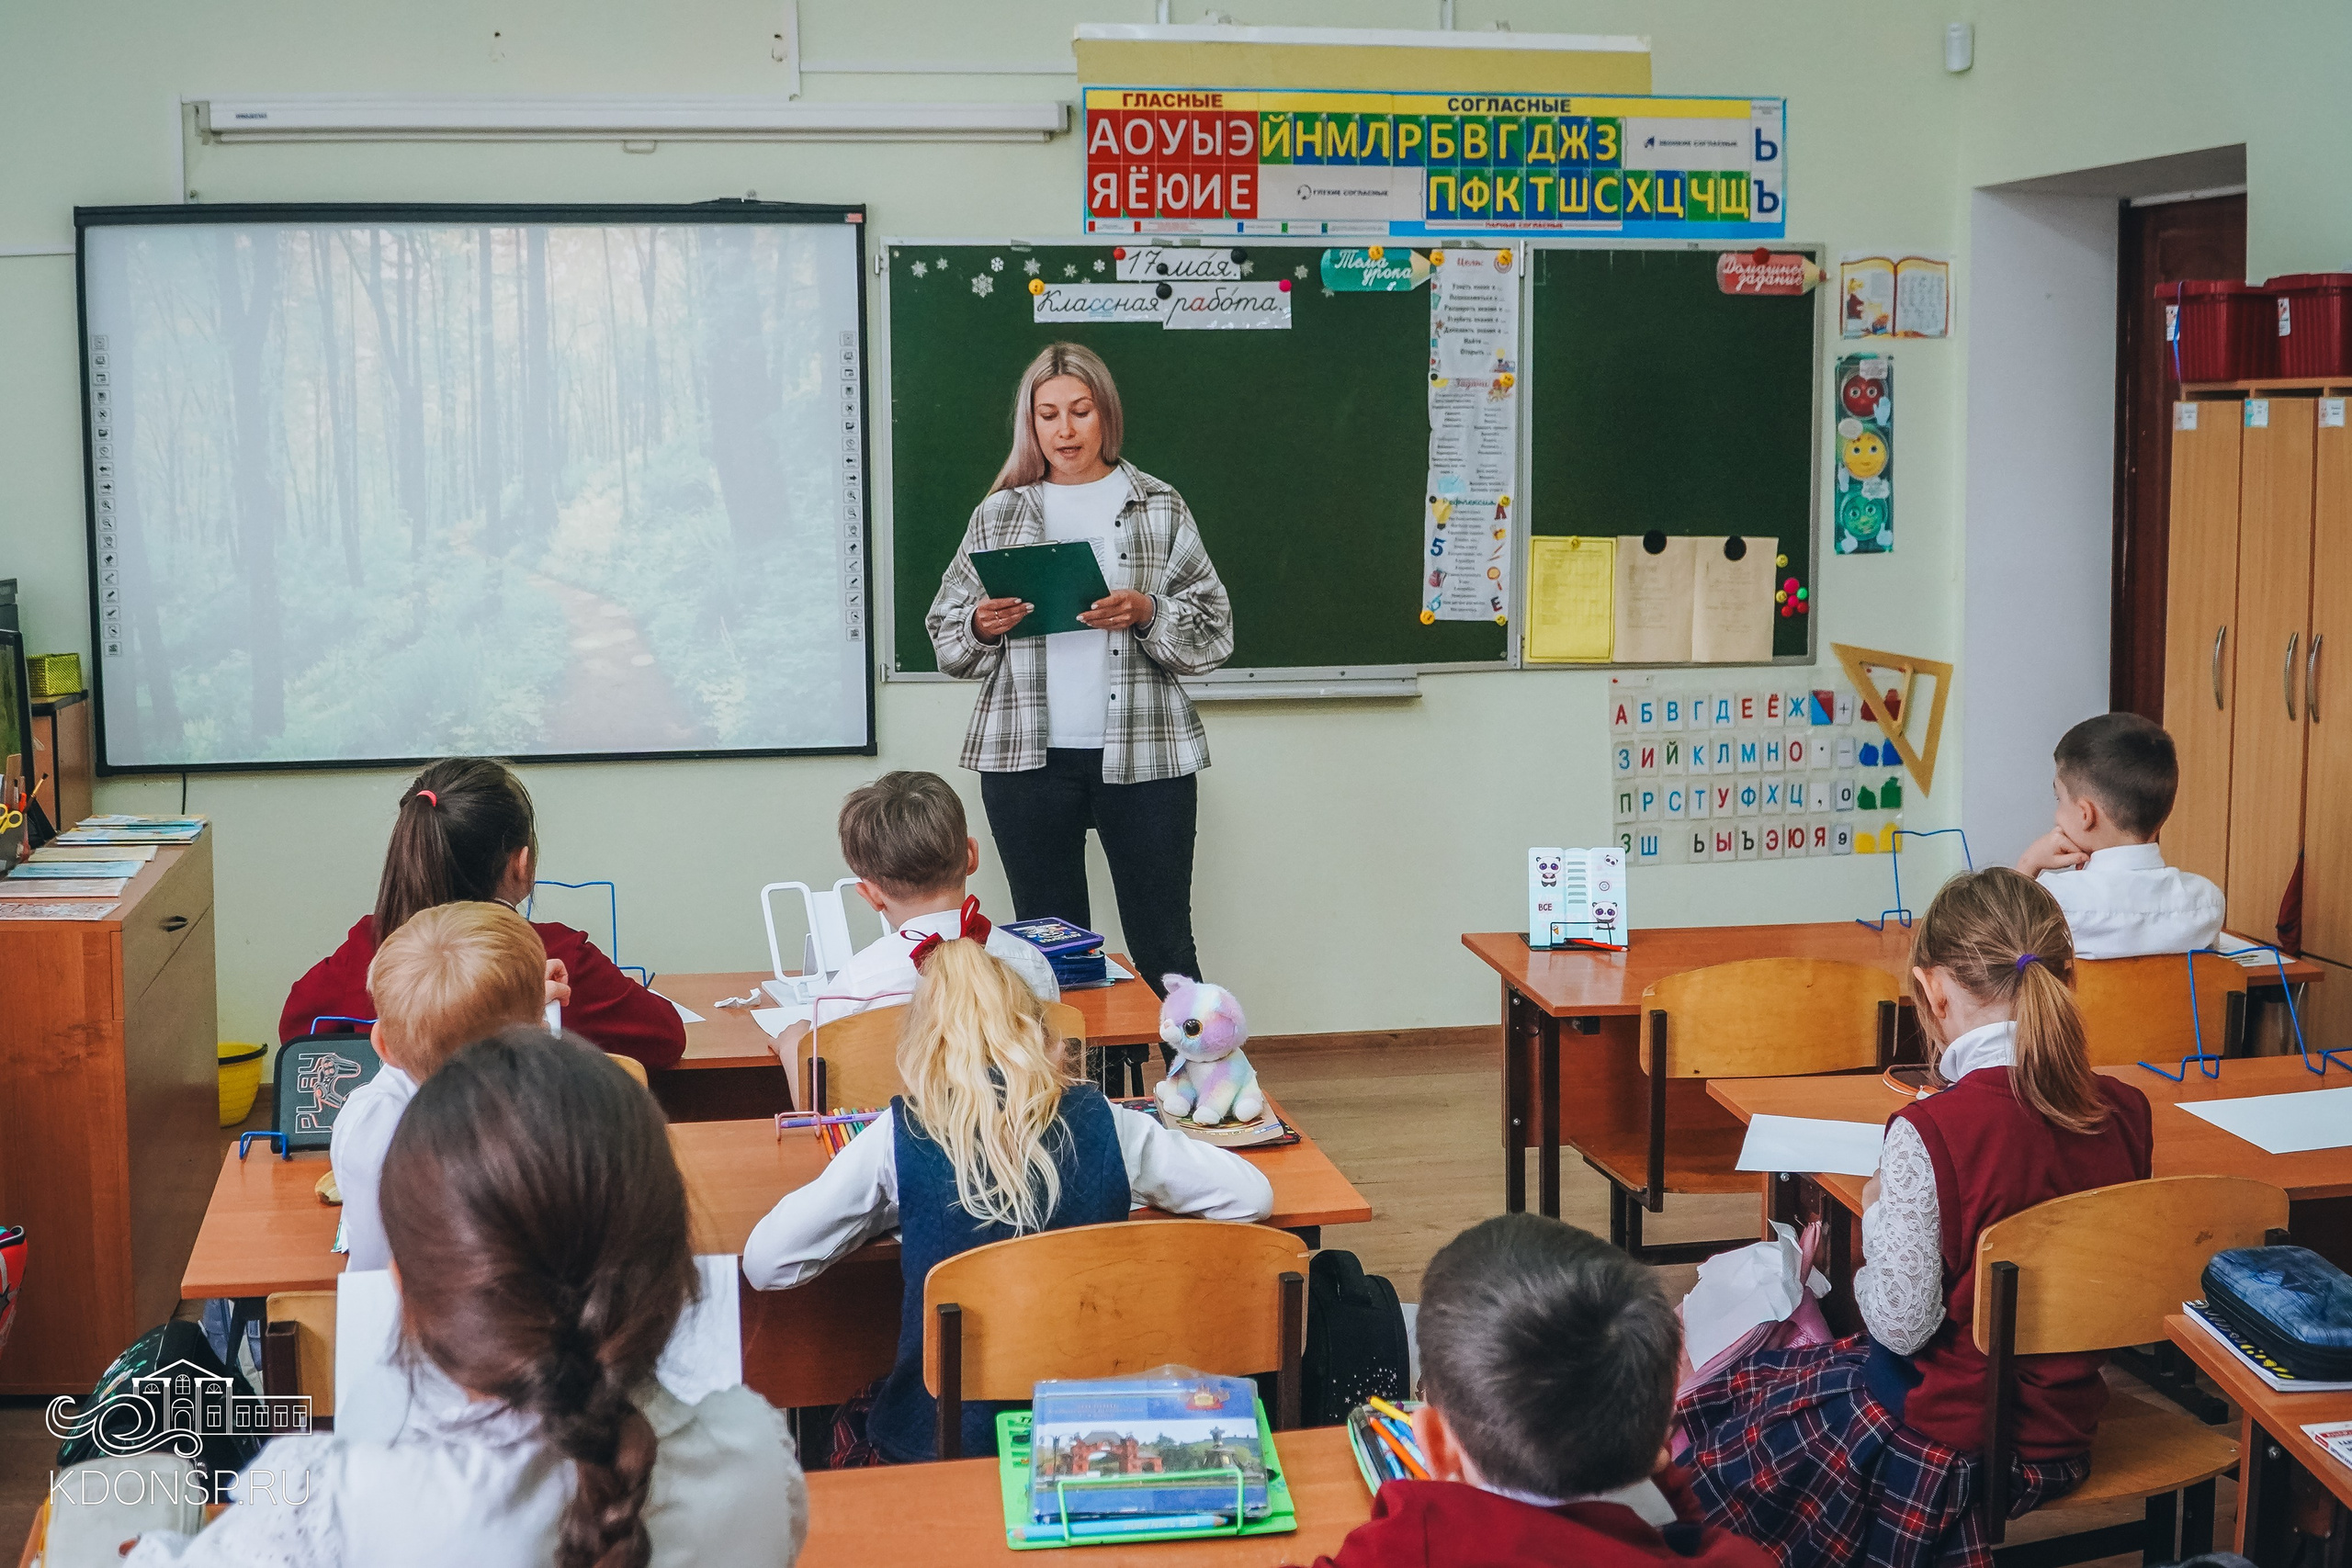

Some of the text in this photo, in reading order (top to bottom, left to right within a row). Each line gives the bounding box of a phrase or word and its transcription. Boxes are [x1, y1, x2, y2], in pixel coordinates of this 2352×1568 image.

[1122, 93, 1223, 108] ГЛАСНЫЕ
[1447, 97, 1571, 113] СОГЛАСНЫЕ
[1128, 250, 1162, 275] 17
[1334, 249, 1389, 269] Тема
[1362, 267, 1413, 287] урока
[1736, 273, 1804, 292] задание
[1036, 289, 1160, 312] Классная
[1430, 537, 1446, 557] 5
[1641, 703, 1653, 723] Б
[1694, 700, 1704, 720] Г
[1716, 700, 1730, 724] Д
[1789, 697, 1805, 717] Ж
[1641, 747, 1655, 768] И
[1717, 743, 1730, 764] Л
[1620, 793, 1632, 814] П
[1741, 786, 1757, 807] Ф
[1790, 784, 1803, 807] Ц
[1641, 836, 1657, 855] Ш
[1716, 831, 1732, 852] Ы
[1766, 829, 1779, 851] Э
[1788, 828, 1805, 849] Ю
[1815, 827, 1826, 847] Я
